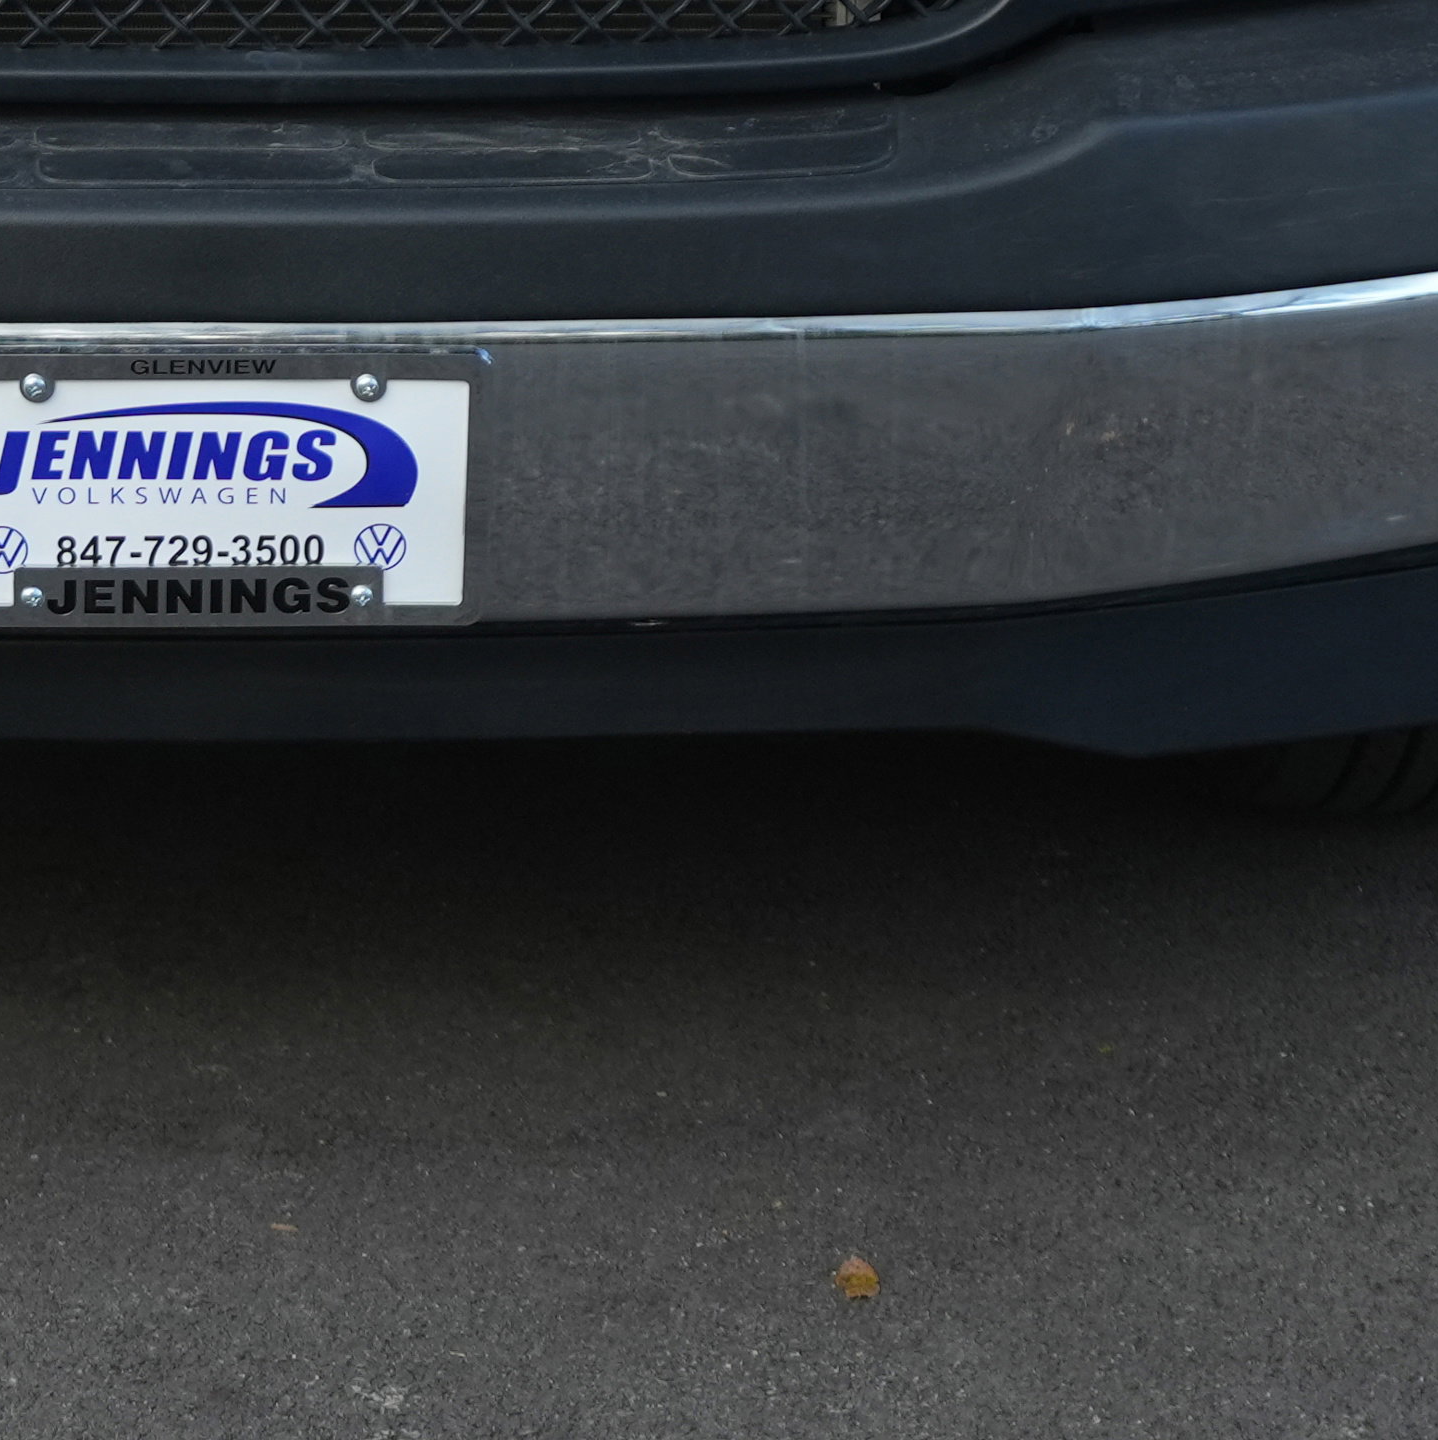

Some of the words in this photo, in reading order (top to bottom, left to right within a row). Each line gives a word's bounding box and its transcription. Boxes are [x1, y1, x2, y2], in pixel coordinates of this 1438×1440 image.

[130, 358, 277, 376] GLENVIEW
[31, 486, 287, 505] VOLKSWAGEN
[55, 533, 325, 567] 847-729-3500
[46, 577, 352, 616] JENNINGS
